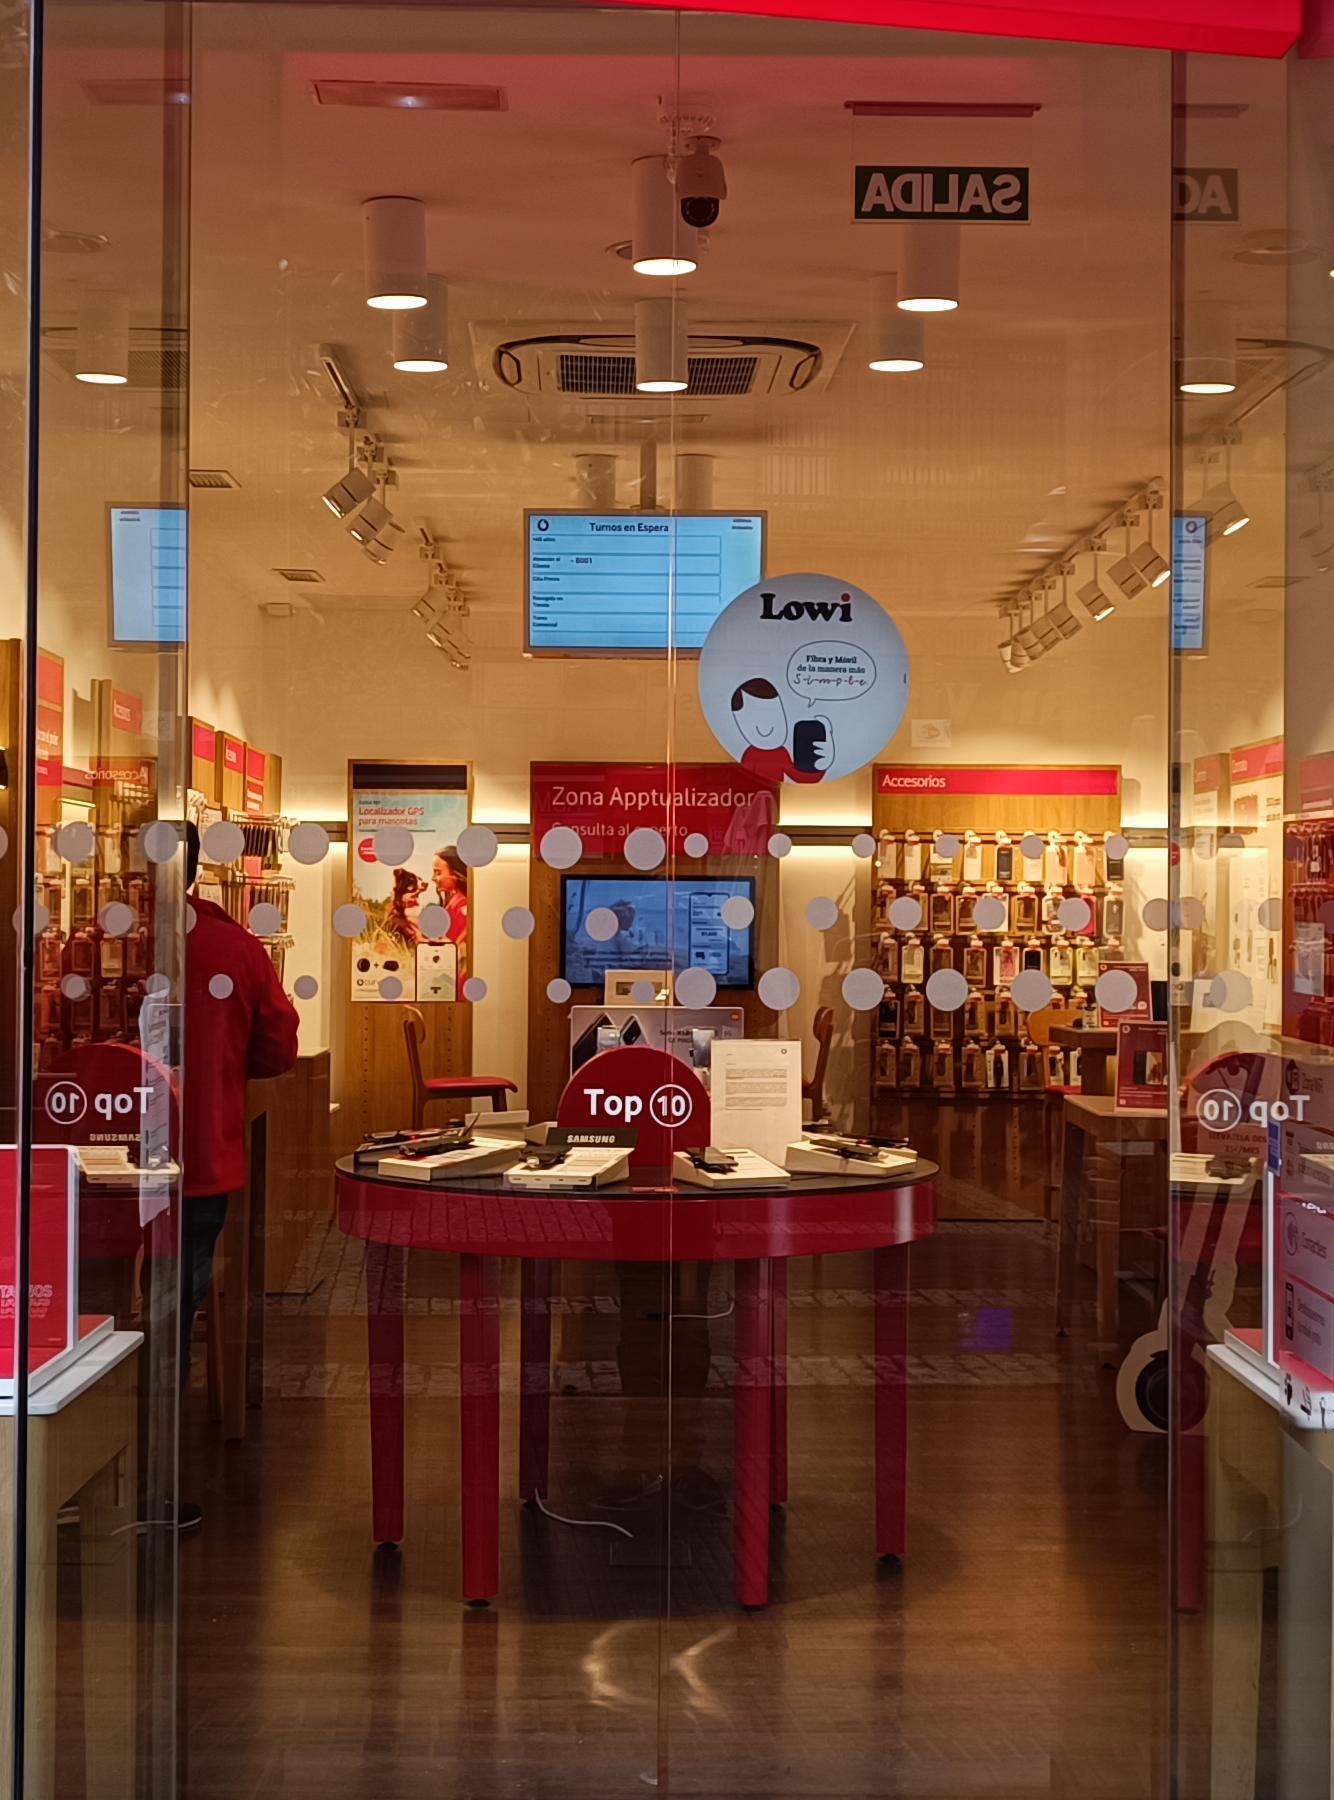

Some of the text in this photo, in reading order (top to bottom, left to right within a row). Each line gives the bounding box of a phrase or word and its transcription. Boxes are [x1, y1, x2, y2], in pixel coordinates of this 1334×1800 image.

[590, 523, 622, 532] Turnos
[638, 523, 669, 533] Espera
[760, 593, 853, 622] Lowi
[806, 655, 826, 663] Fibra
[809, 664, 815, 672] la
[882, 774, 946, 789] Accesorios
[551, 786, 755, 811] Zona Apptualizador
[359, 807, 424, 815] Localizador GPS
[359, 818, 376, 826] para
[618, 823, 629, 836] al
[583, 1088, 686, 1122] Top 10
[567, 1134, 616, 1145] SAMSUNG
